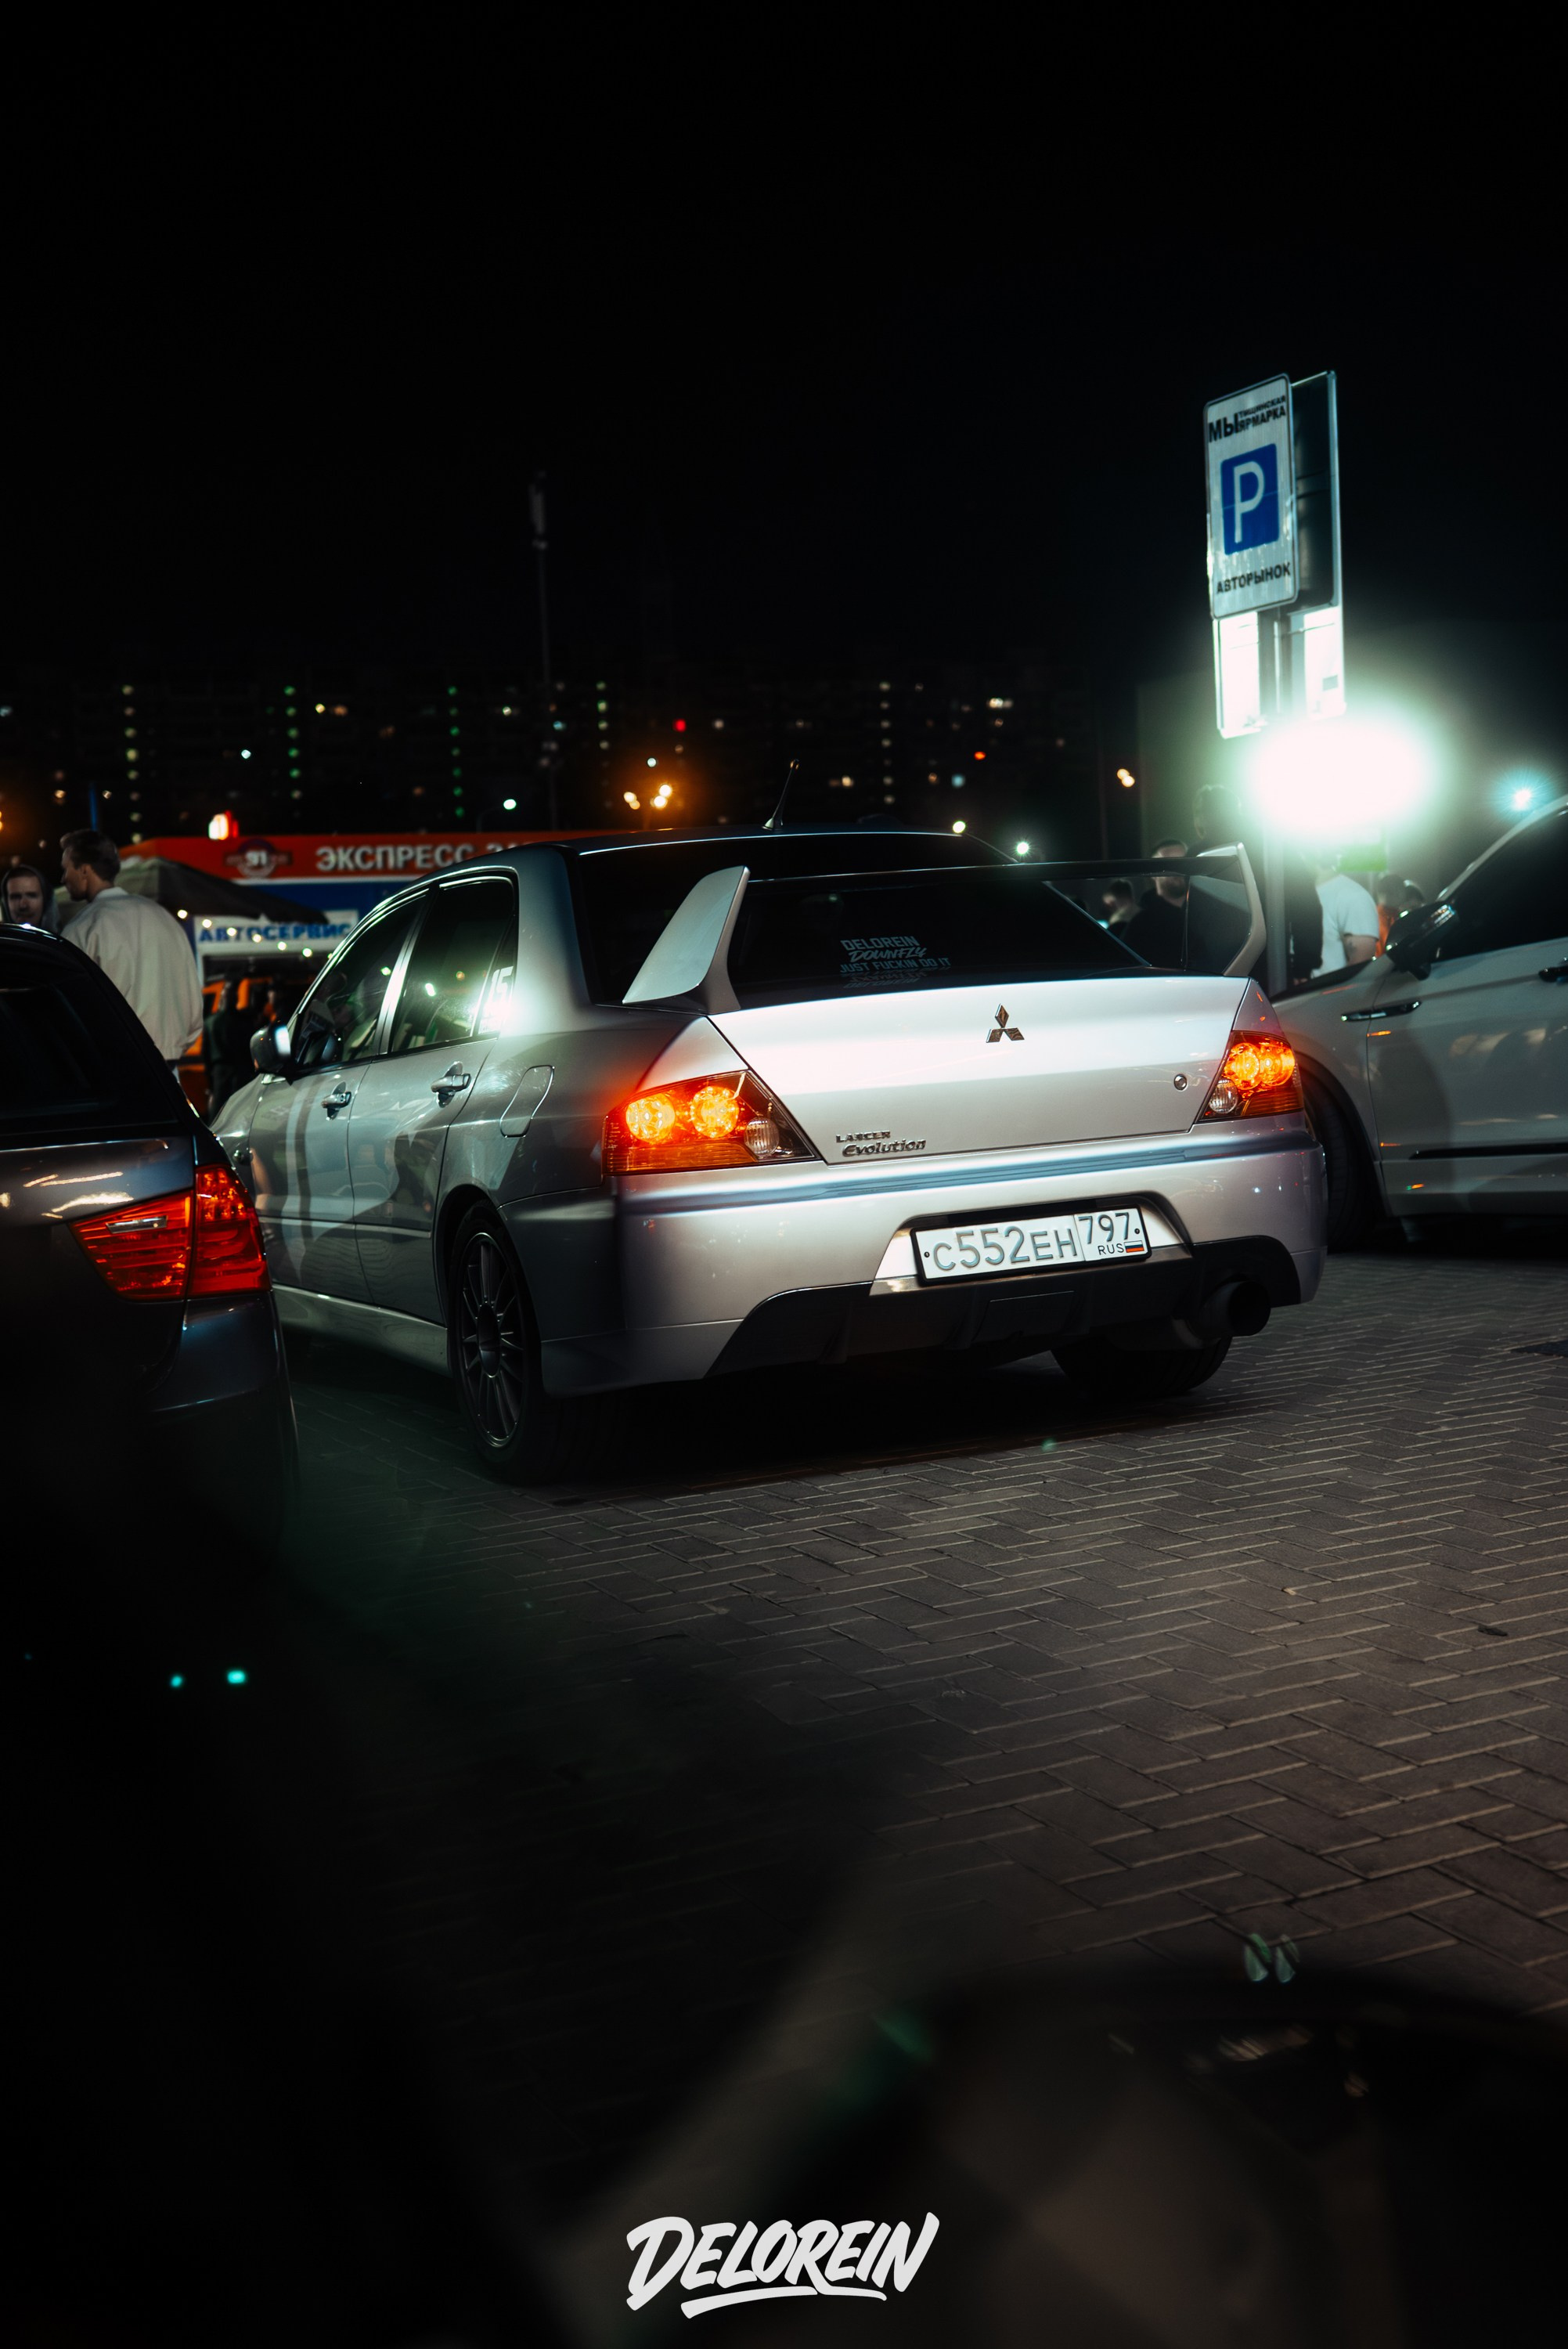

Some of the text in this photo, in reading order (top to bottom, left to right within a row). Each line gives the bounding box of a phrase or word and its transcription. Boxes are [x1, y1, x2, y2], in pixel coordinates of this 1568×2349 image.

[1209, 413, 1239, 442] МЫ
[1238, 406, 1285, 431] ЯРМАРКА
[1216, 561, 1291, 595] АВТОРЫНОК
[315, 843, 474, 871] ЭКСПРЕСС
[200, 923, 351, 942] АВТОСЕРВИС
[839, 935, 921, 951] DELOREIN
[847, 947, 928, 962] DOWNFLY
[839, 957, 952, 973] JUST FUCKIN DO IT
[835, 1130, 891, 1143] LANCER
[842, 1138, 927, 1157] Evolution
[932, 1211, 1131, 1272] С552ЕН 797
[1097, 1243, 1125, 1256] RUS
